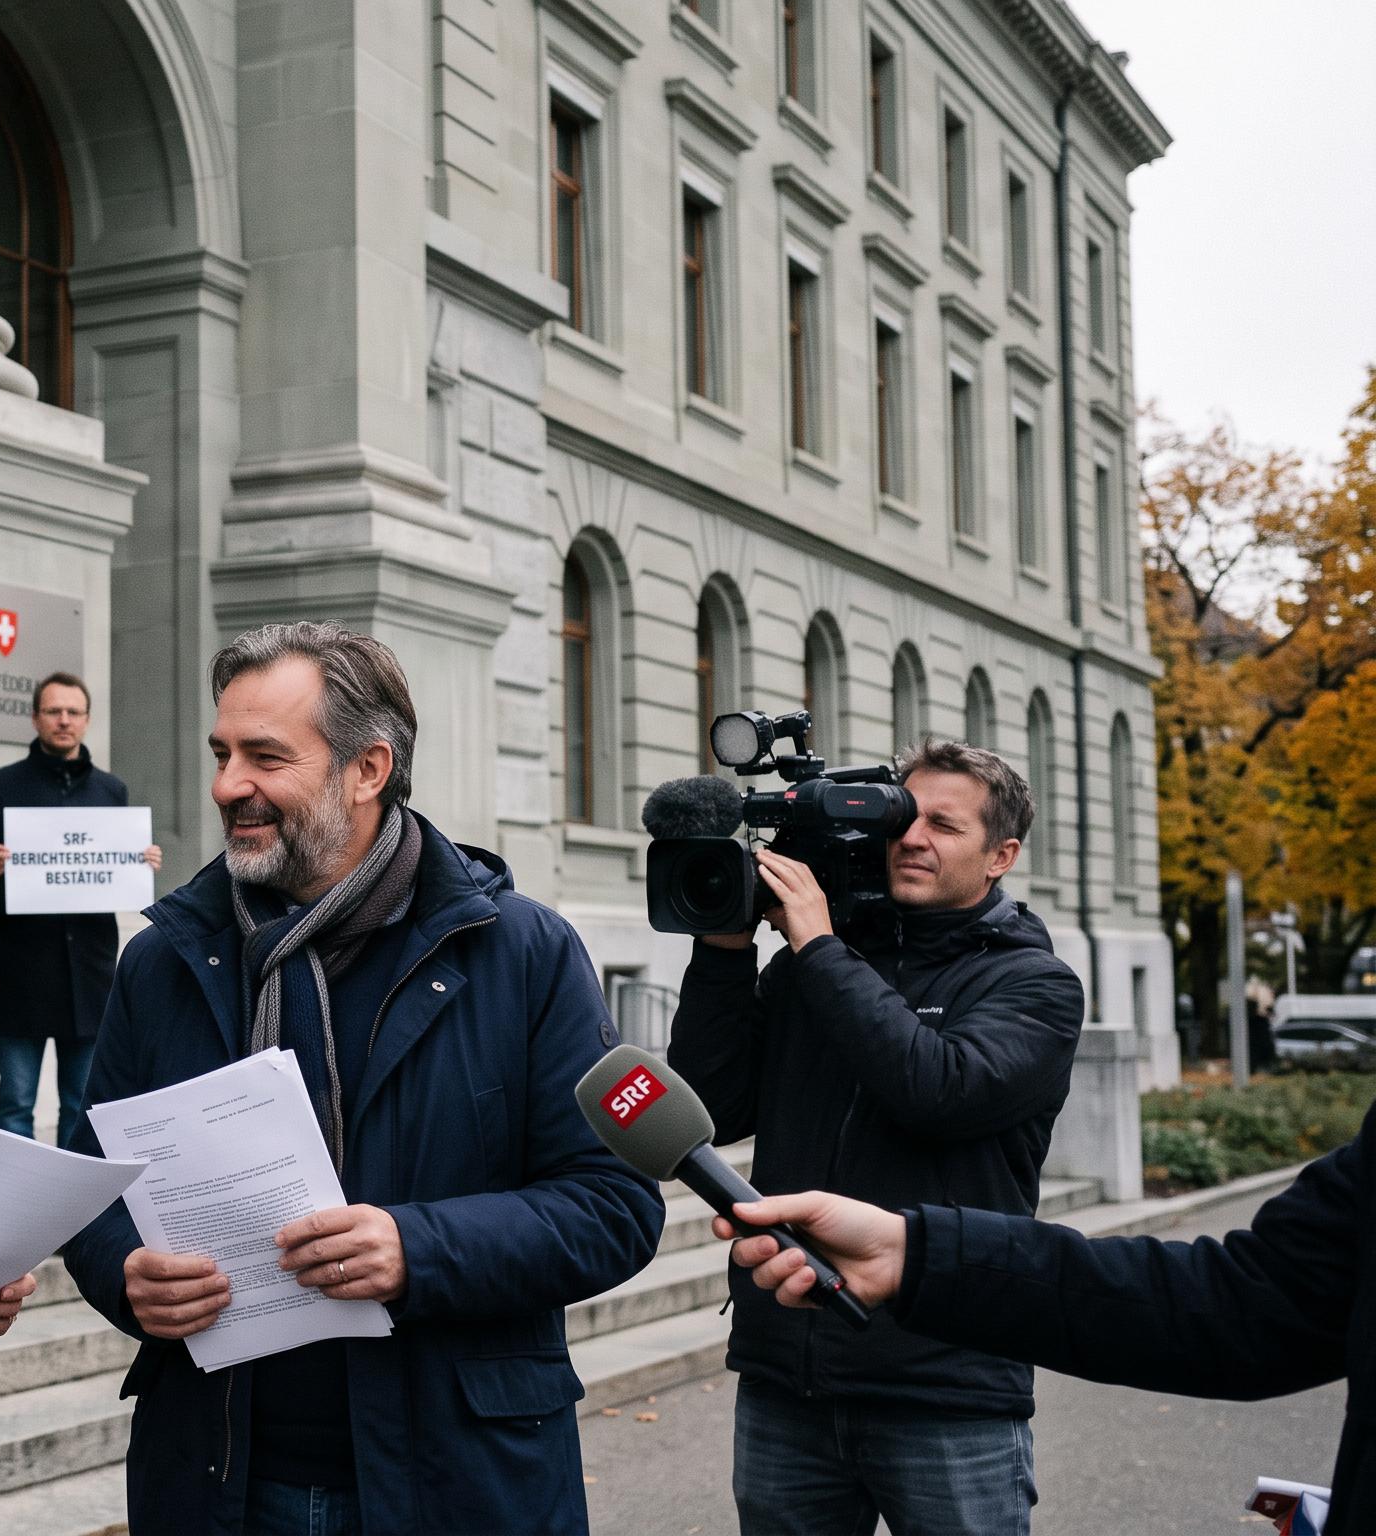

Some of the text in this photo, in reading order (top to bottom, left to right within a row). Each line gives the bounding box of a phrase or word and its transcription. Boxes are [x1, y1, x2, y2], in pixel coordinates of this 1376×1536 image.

[63, 832, 94, 845] SRF-
[12, 852, 145, 865] BERICHTERSTATTUNG
[46, 869, 113, 884] BESTÄTIGT
[611, 1074, 651, 1118] SRF
